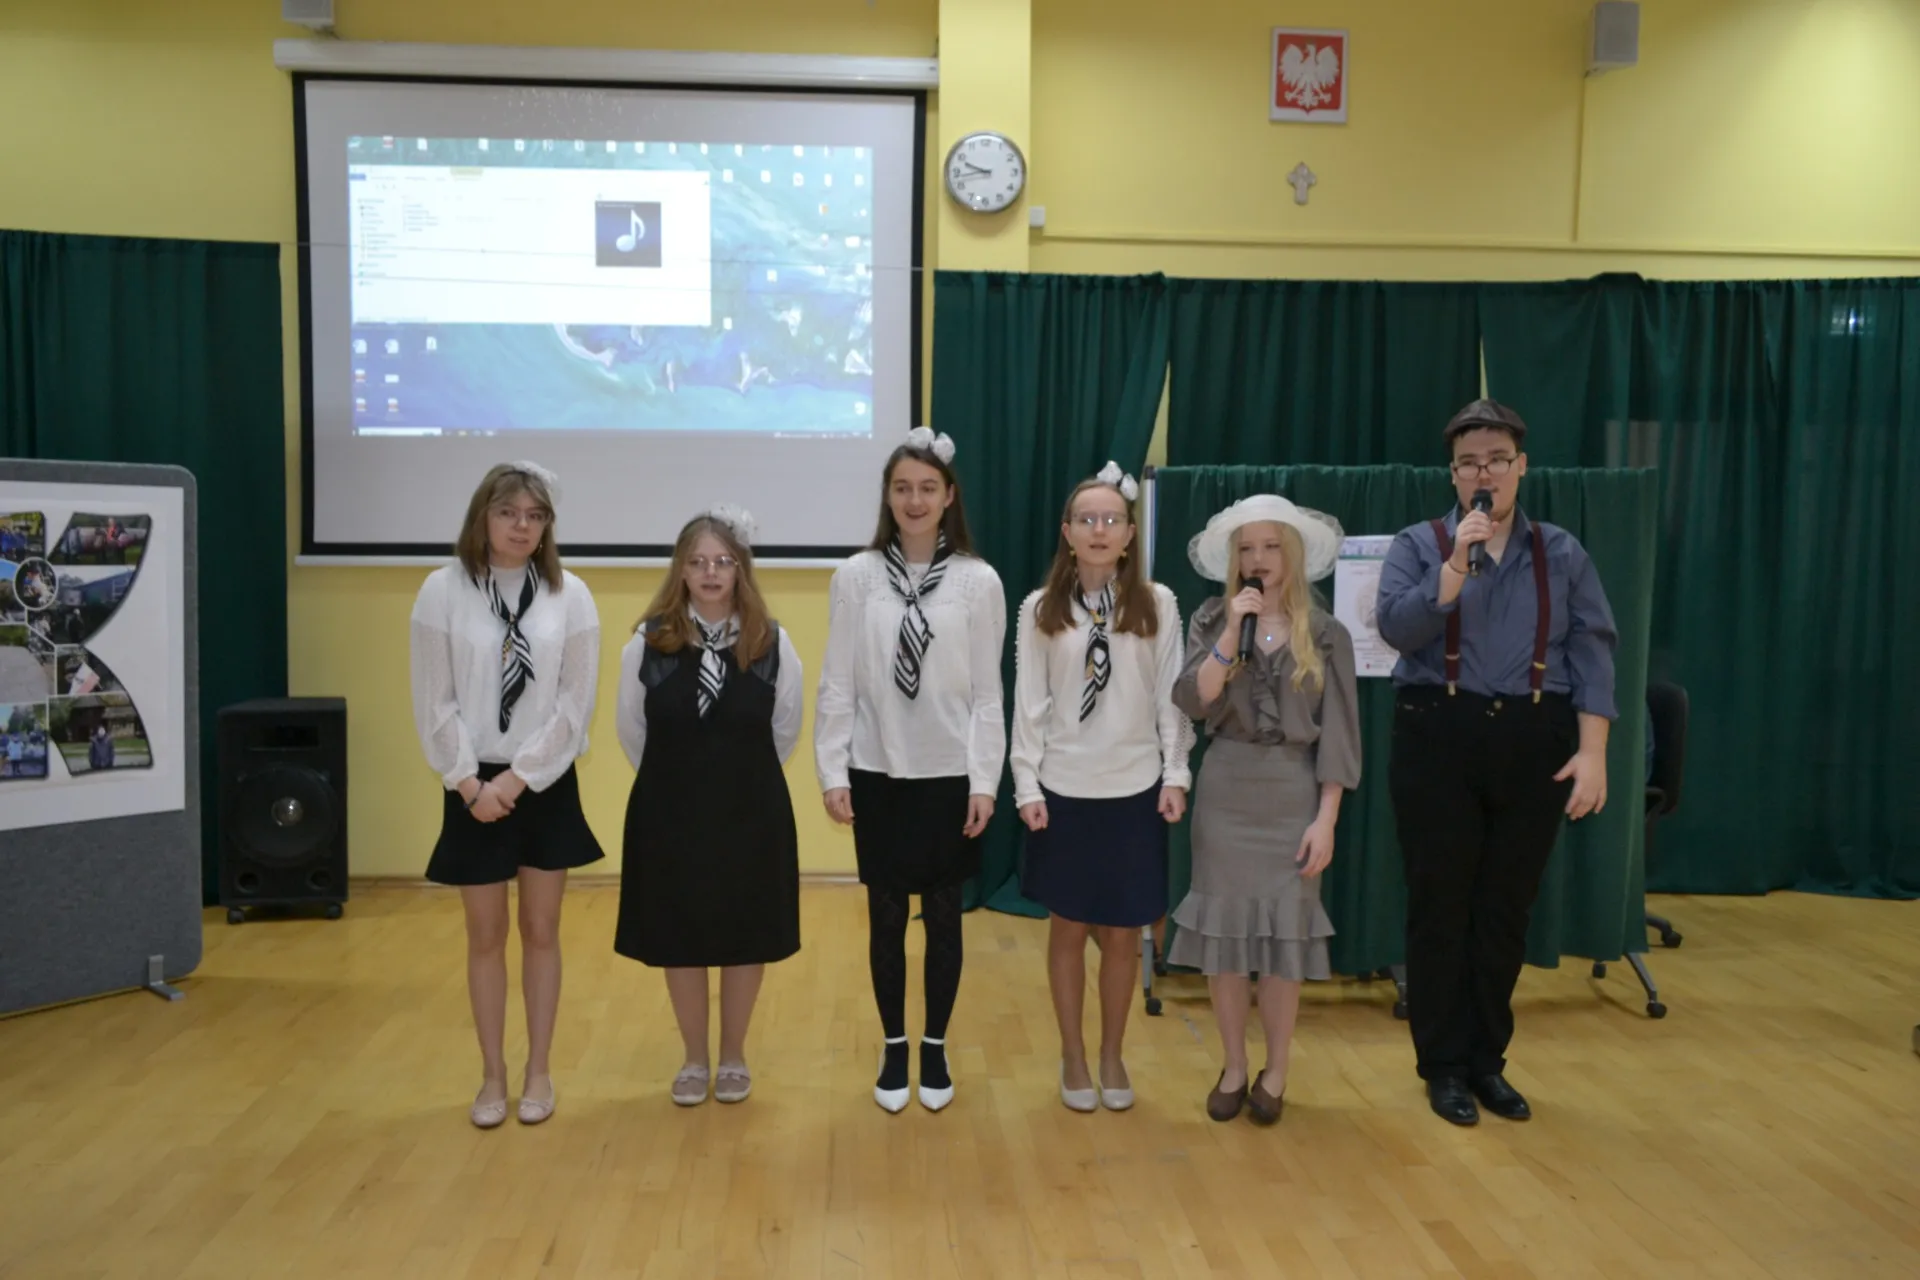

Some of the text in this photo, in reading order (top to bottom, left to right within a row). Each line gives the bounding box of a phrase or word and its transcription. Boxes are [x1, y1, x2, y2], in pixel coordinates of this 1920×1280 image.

[1006, 153, 1015, 163] 2
[952, 168, 961, 178] 9
[1010, 168, 1019, 178] 3
[1006, 183, 1014, 192] 4
[967, 192, 975, 202] 7
